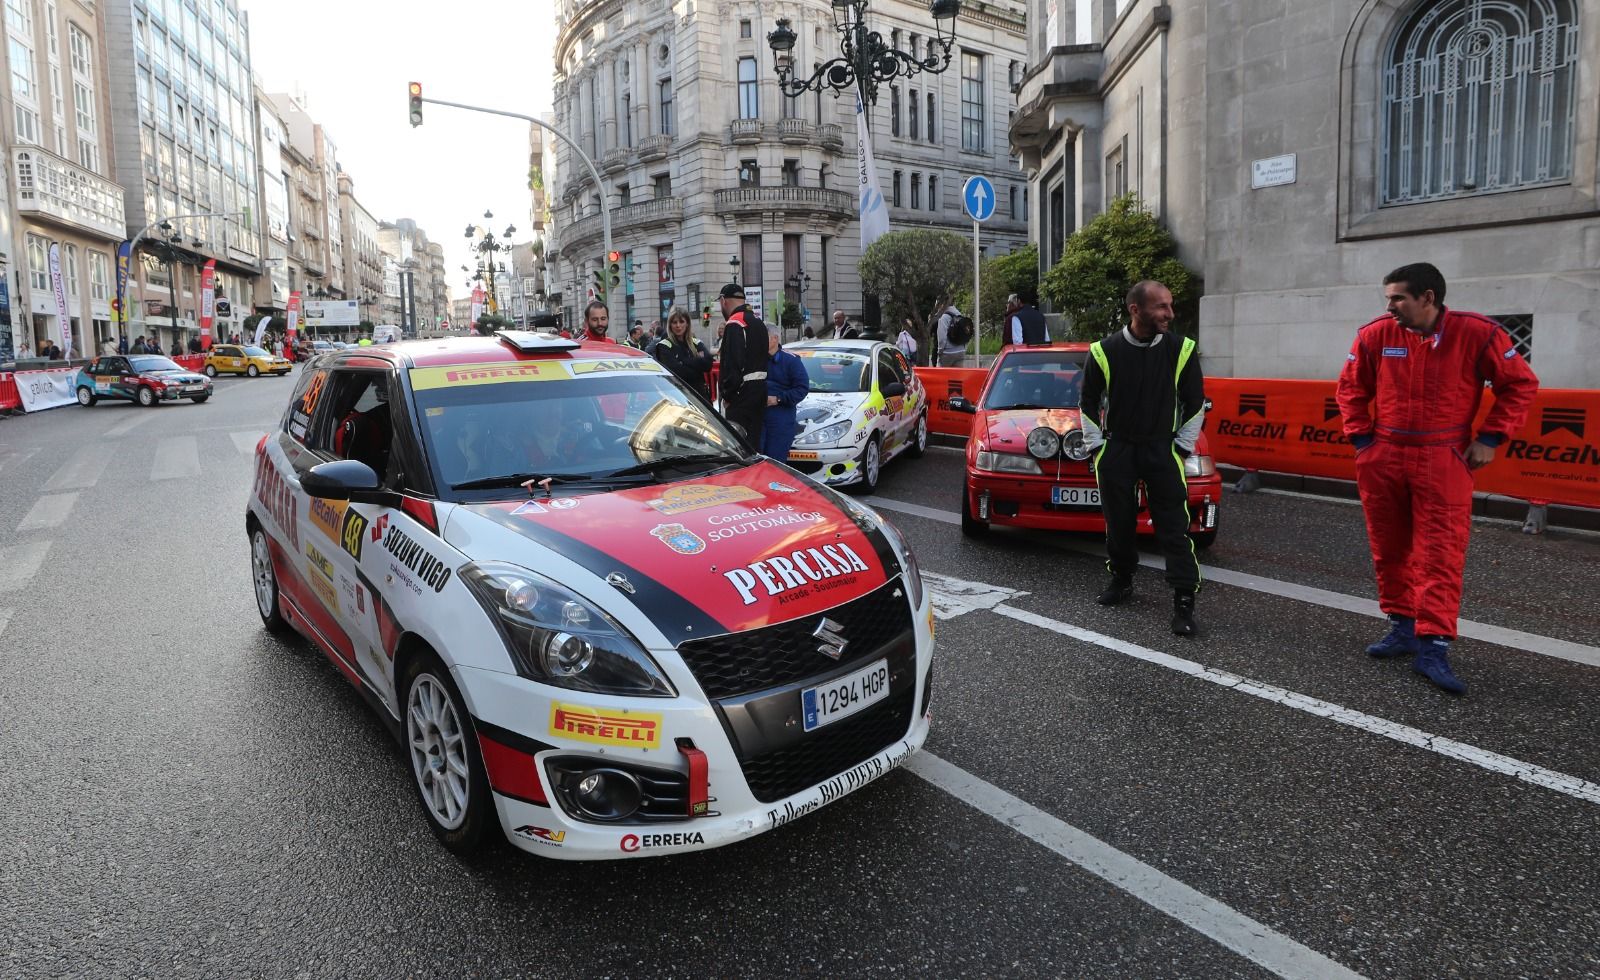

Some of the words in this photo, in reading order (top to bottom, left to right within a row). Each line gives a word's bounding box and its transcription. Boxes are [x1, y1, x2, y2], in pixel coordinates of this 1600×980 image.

[446, 365, 540, 382] PIRELLI
[30, 382, 54, 404] galicia
[303, 370, 326, 415] 48
[1217, 419, 1287, 440] Recalvi
[1300, 425, 1354, 445] Reca
[1505, 440, 1600, 465] Recalv
[1520, 470, 1599, 483] www.recalvi.es
[1061, 489, 1079, 503] CO
[1083, 490, 1099, 503] 16
[312, 497, 341, 532] Recalvi
[708, 507, 775, 525] Concello
[777, 504, 794, 513] de
[708, 511, 826, 542] SOUTOMAIOR
[345, 514, 362, 556] 48
[383, 525, 424, 571] SUZUKI
[417, 551, 451, 593] VIGO
[723, 542, 869, 605] PERCASA
[778, 590, 809, 605] Arcade
[815, 576, 857, 593] Soutomaior
[820, 681, 858, 716] 1294
[862, 668, 886, 699] HGP
[554, 709, 656, 741] PIRELLI
[807, 713, 814, 722] E
[768, 798, 818, 828] Talleres
[643, 832, 704, 847] ERREKA
